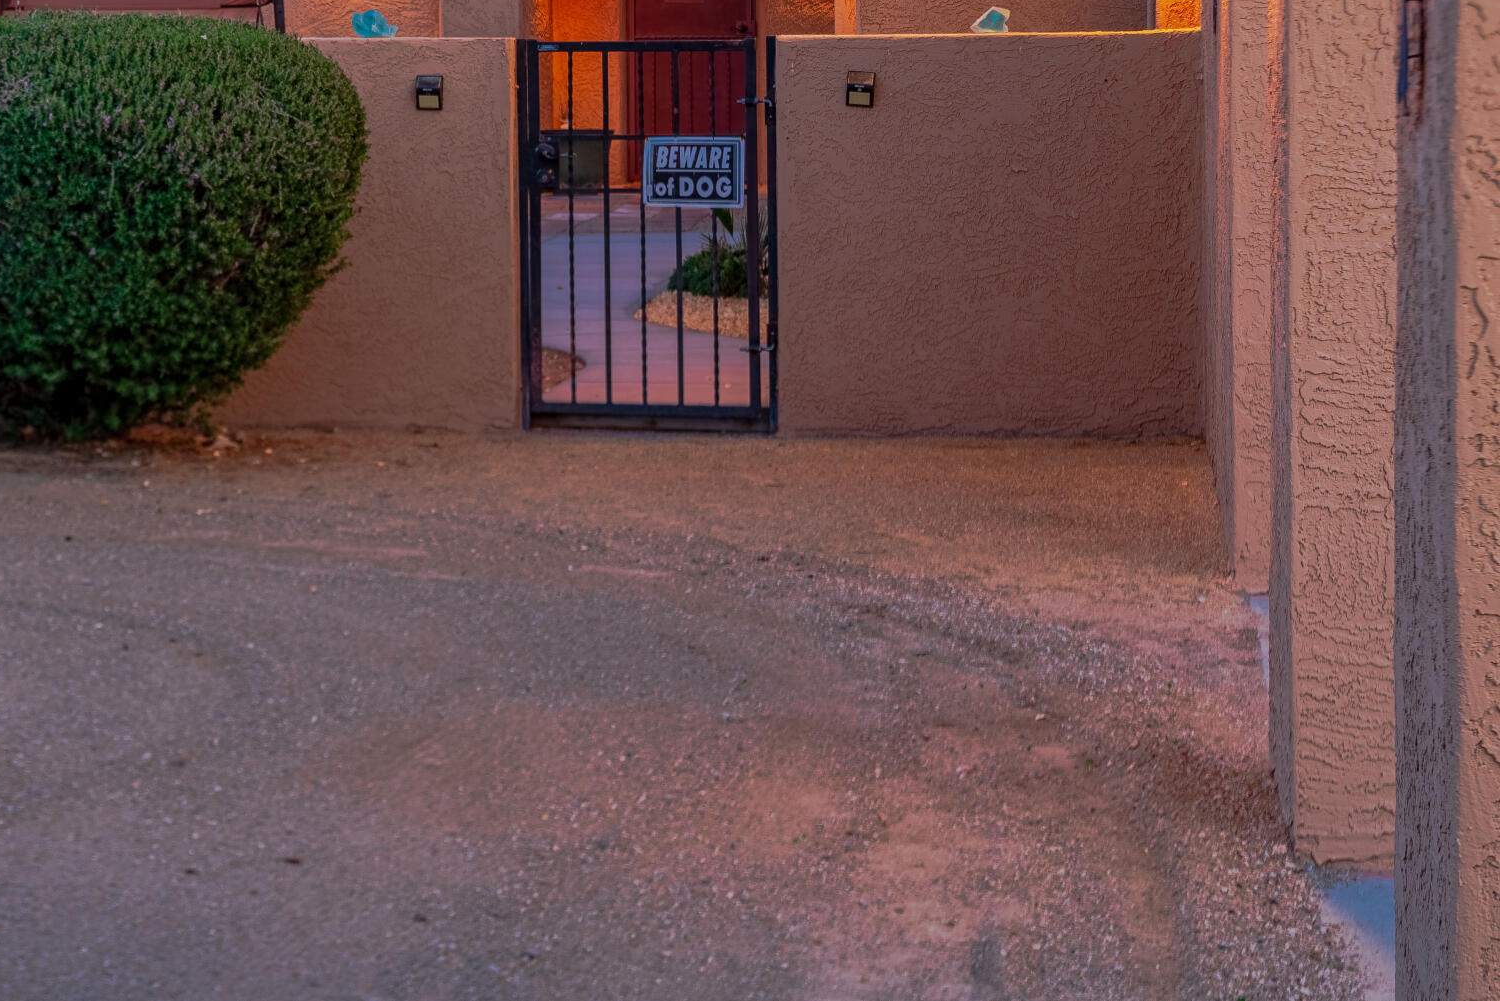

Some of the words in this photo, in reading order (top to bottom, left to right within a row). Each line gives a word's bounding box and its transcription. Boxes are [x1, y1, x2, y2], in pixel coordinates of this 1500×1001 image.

[656, 145, 732, 169] BEWARE
[655, 177, 675, 197] of
[679, 176, 732, 198] DOG
